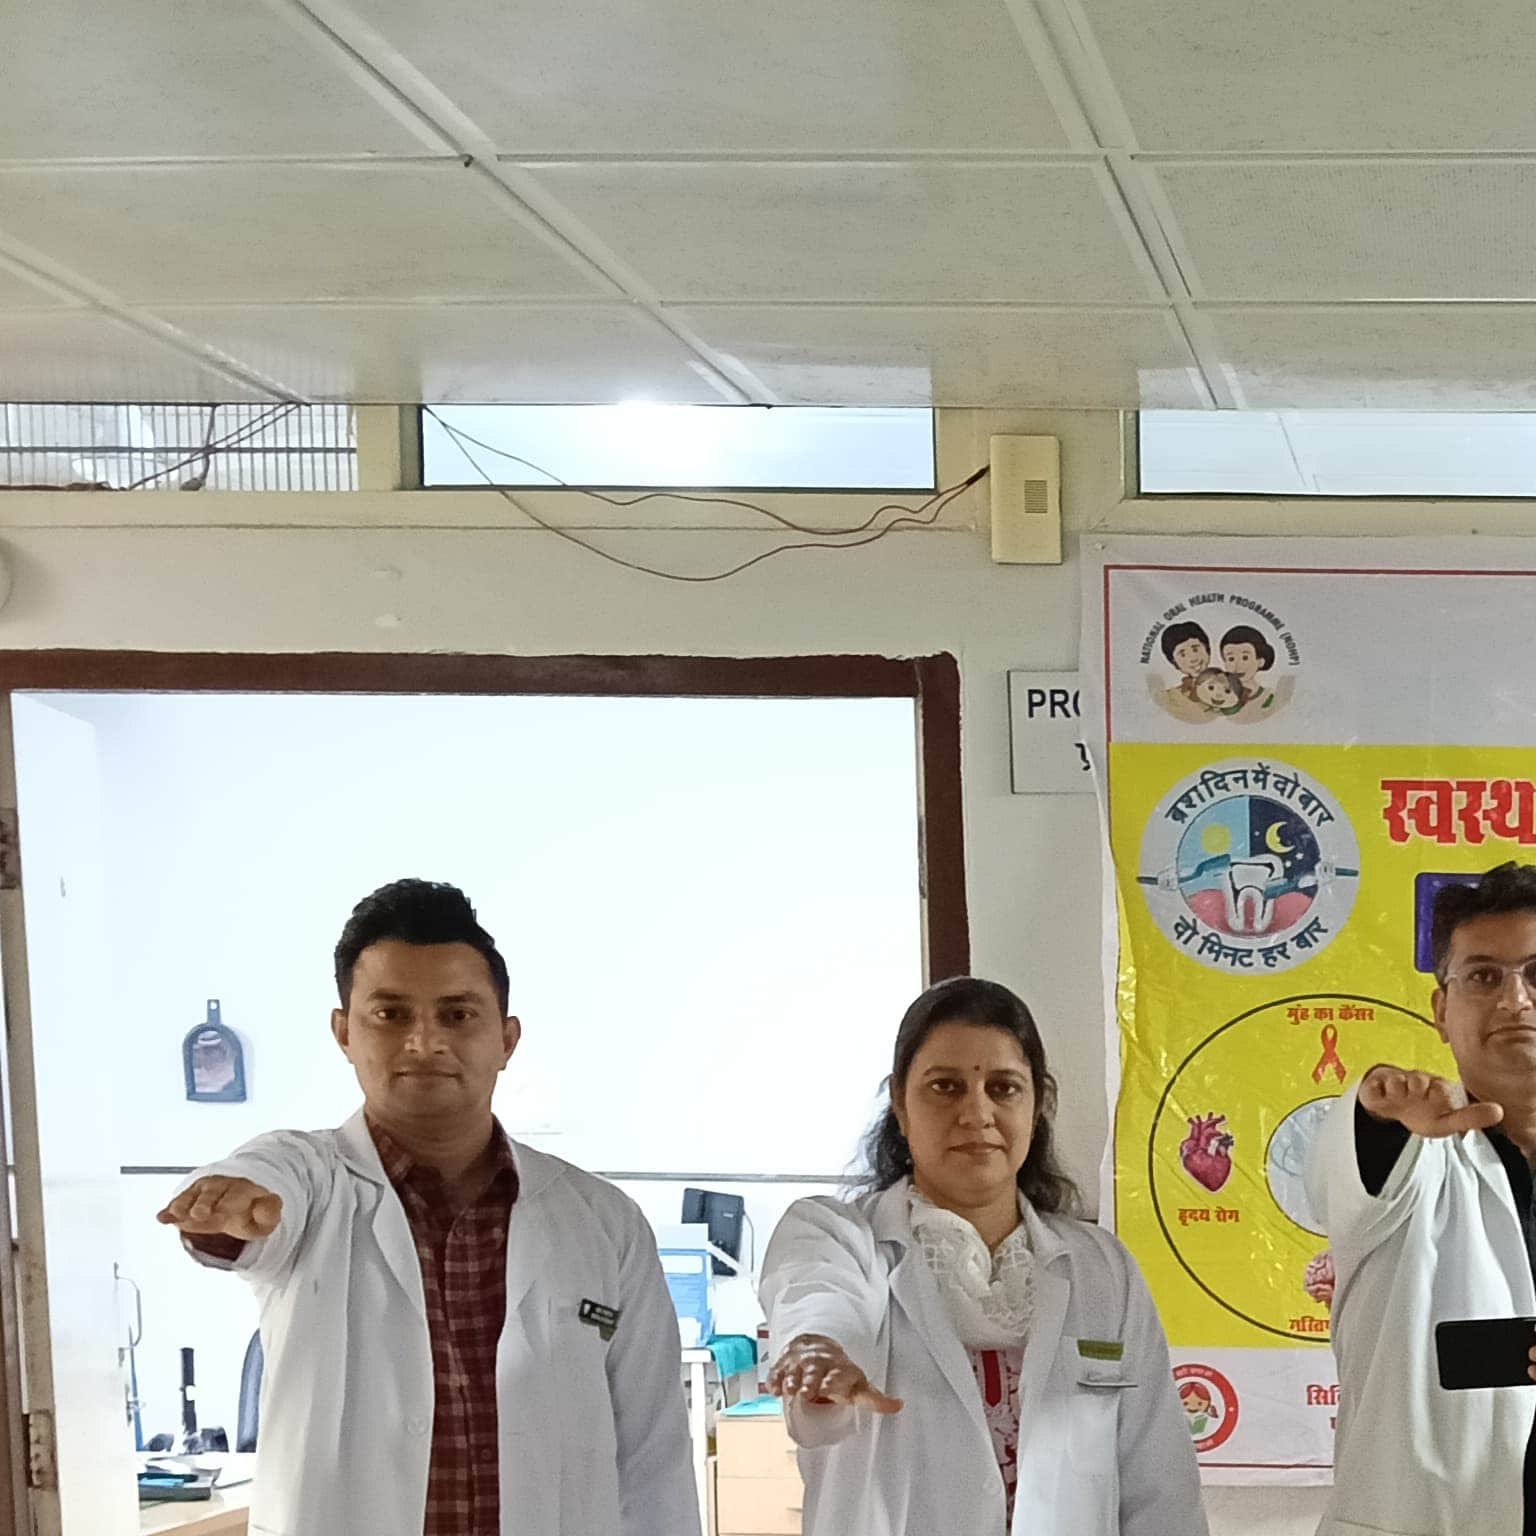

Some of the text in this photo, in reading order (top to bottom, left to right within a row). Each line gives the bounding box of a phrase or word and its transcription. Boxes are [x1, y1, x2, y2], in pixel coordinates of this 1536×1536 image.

[1140, 622, 1165, 664] NATIONAL
[1163, 603, 1187, 621] ORAL
[1188, 593, 1225, 607] HEALTH
[1229, 594, 1286, 631] PROGRAMME
[1200, 770, 1249, 798] दिन
[1251, 762, 1271, 790] में
[1272, 773, 1301, 800] दो
[1298, 787, 1334, 827] बार
[1197, 932, 1254, 968] मिनट
[1257, 942, 1291, 968] हर
[1291, 916, 1329, 950] बार
